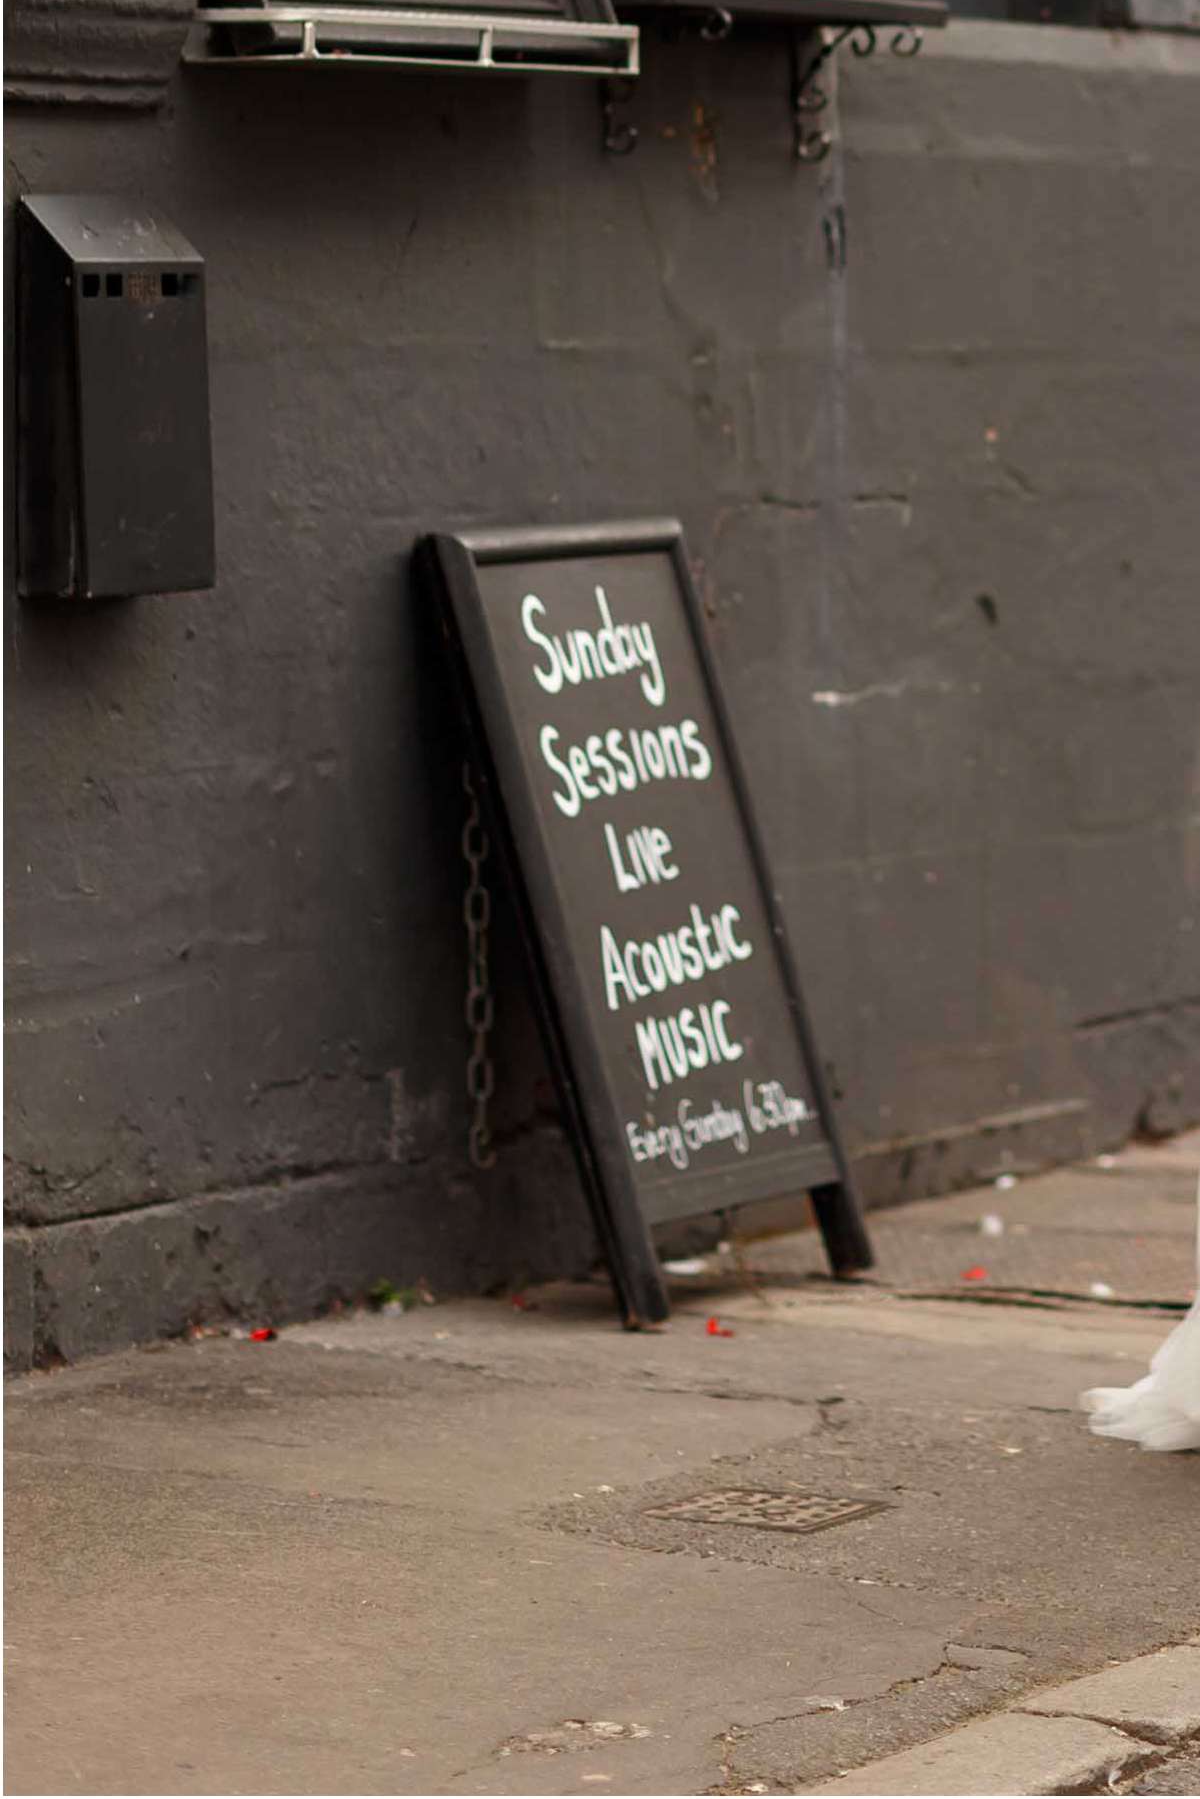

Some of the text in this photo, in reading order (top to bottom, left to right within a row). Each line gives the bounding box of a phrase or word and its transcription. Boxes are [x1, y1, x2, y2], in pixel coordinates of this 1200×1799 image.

[521, 585, 666, 707] Sunday
[540, 719, 712, 818] Sessions
[635, 999, 743, 1090] MUSIC
